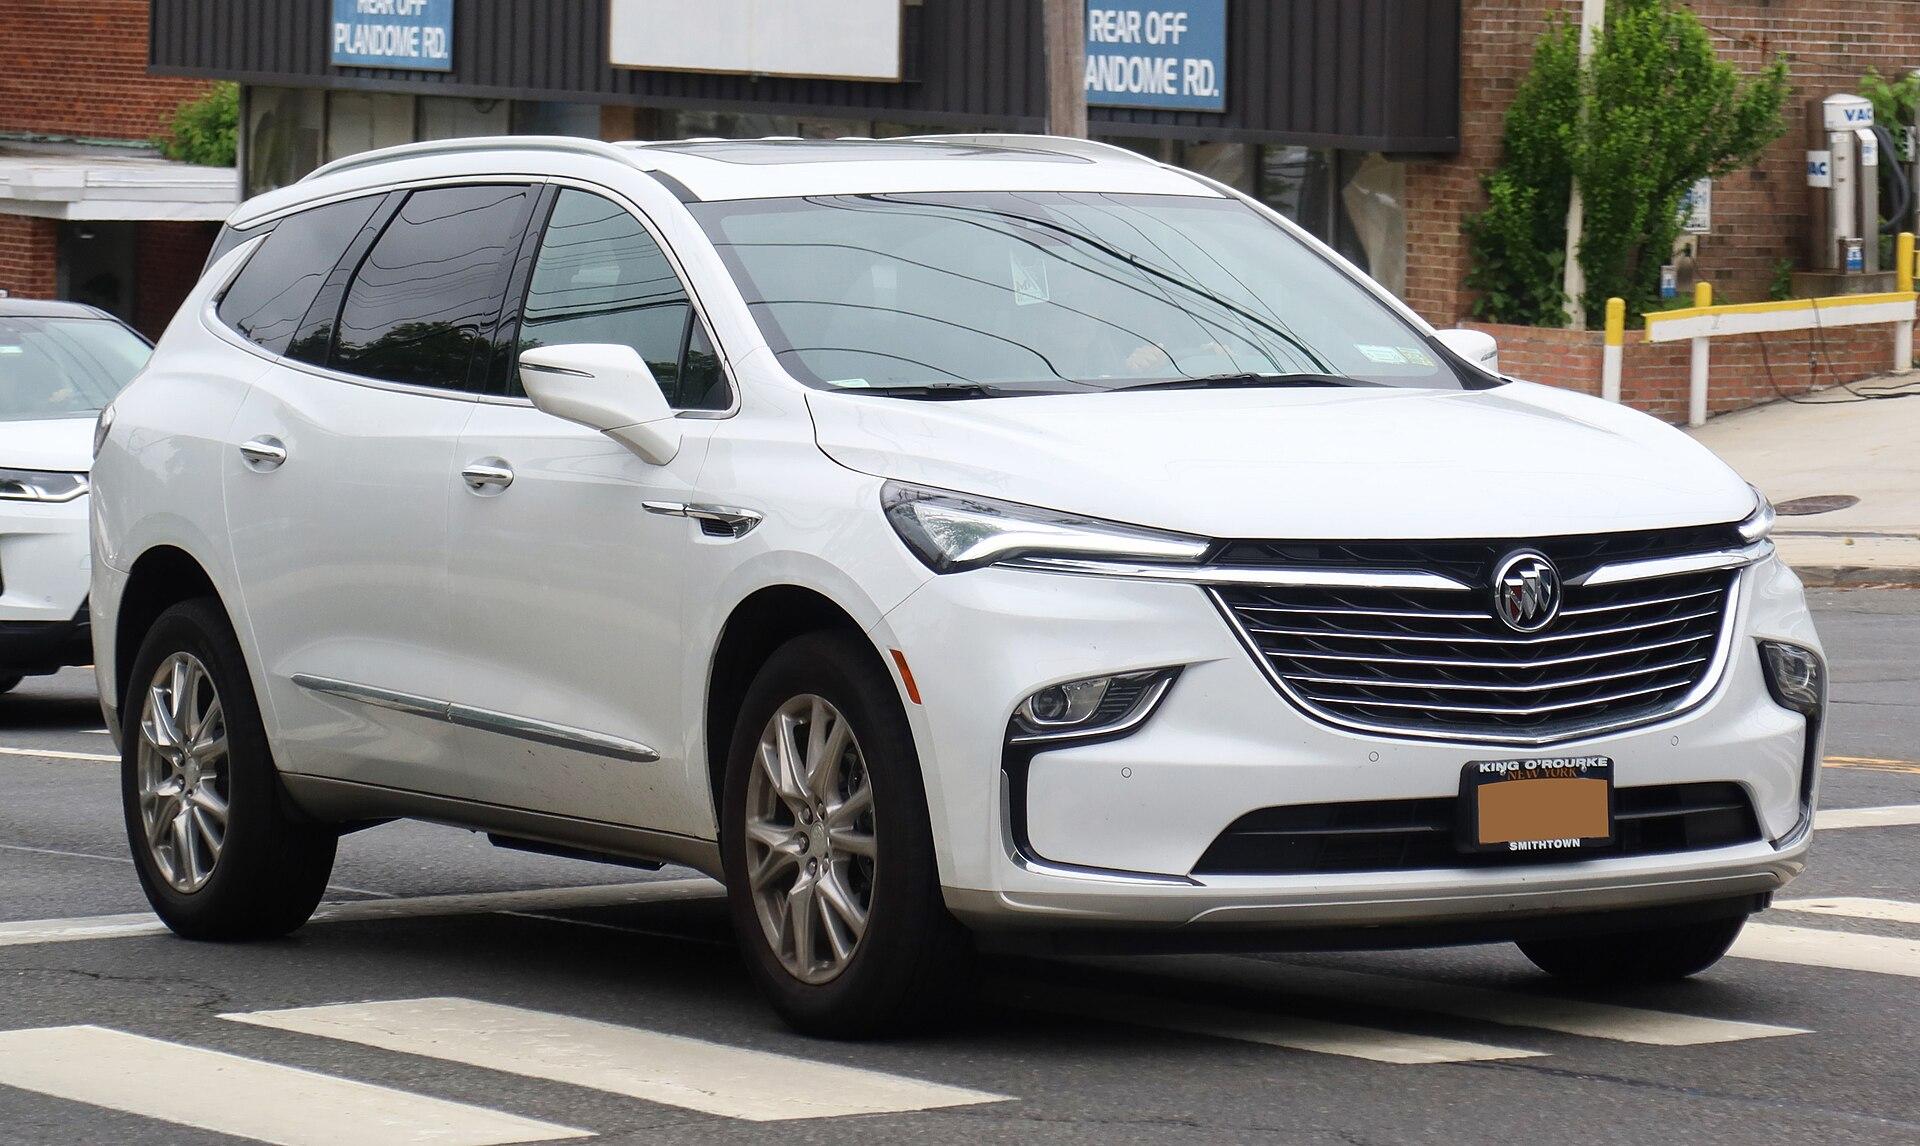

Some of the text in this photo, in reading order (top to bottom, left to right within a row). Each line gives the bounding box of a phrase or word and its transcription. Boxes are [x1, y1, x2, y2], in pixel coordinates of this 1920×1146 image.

[1089, 9, 1188, 45] REAR OFF
[334, 22, 448, 59] PLANDOME RD.
[1084, 54, 1220, 97] ANDOME RD.
[1479, 757, 1608, 773] KING O'ROURKE
[1507, 766, 1577, 780] NEW YORK
[1509, 838, 1581, 851] SMITHTOWN
